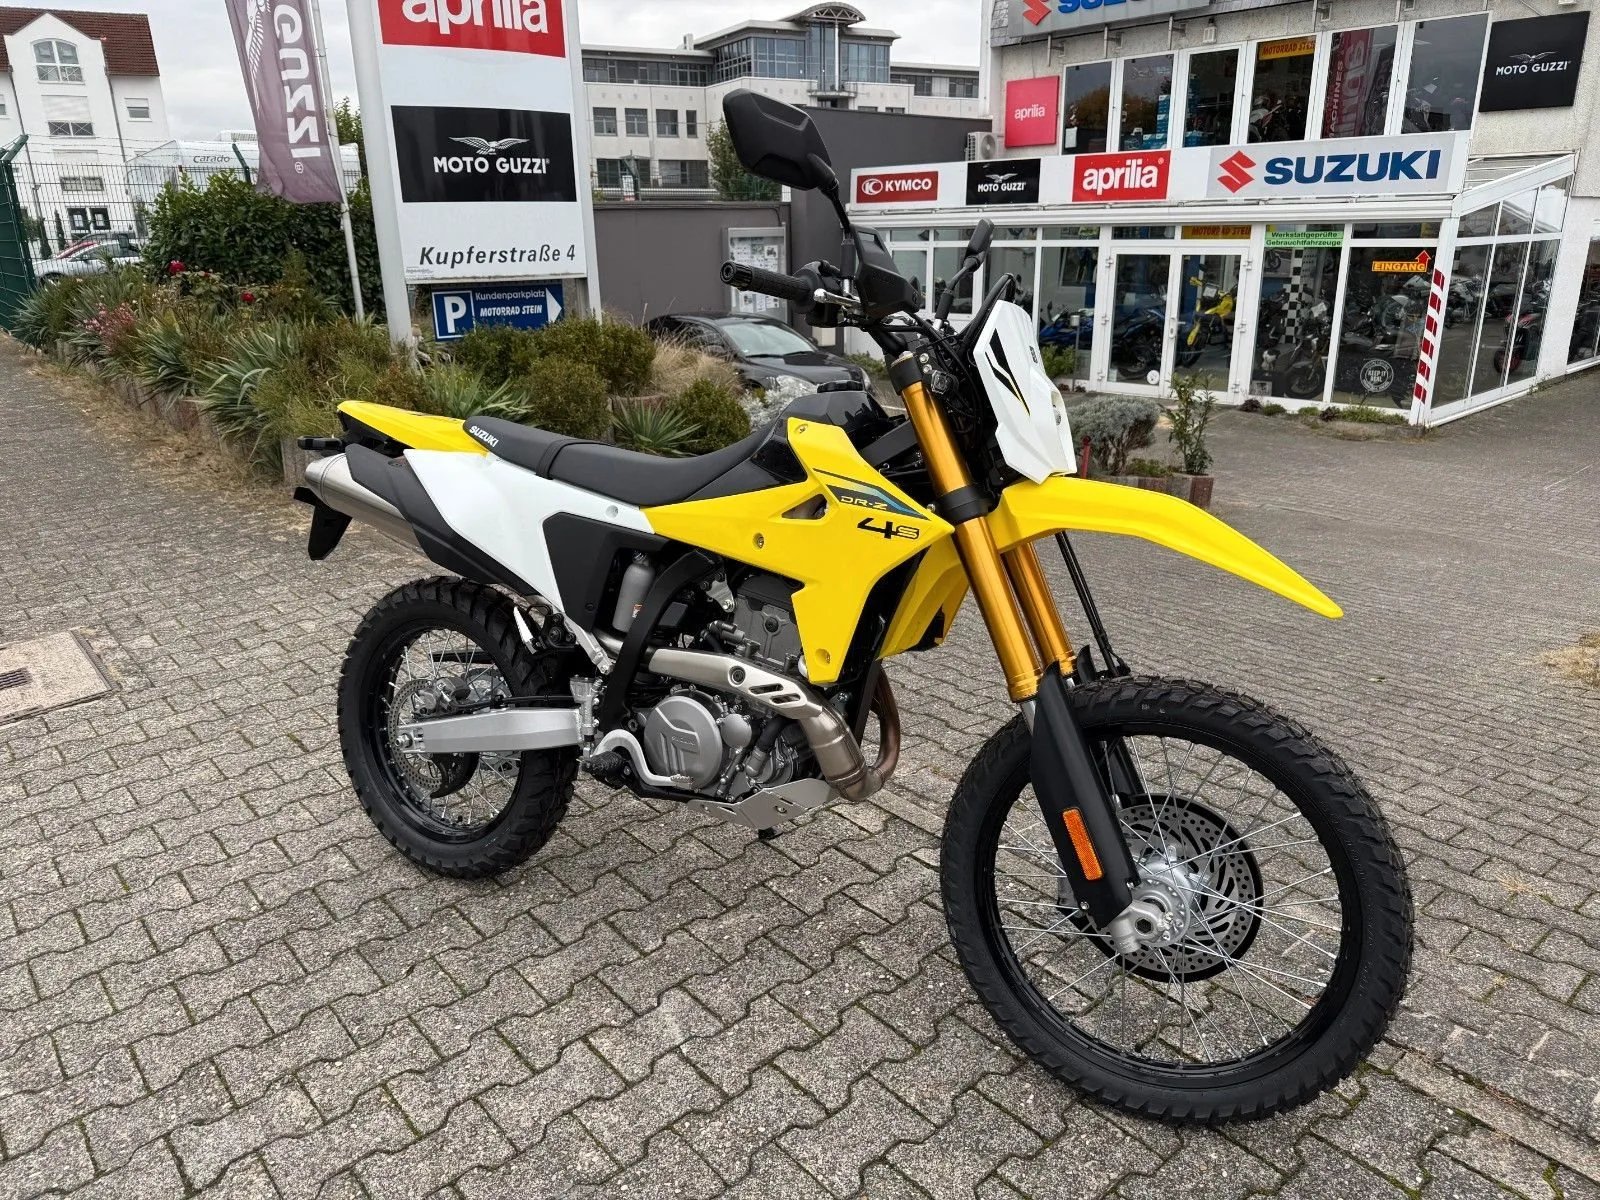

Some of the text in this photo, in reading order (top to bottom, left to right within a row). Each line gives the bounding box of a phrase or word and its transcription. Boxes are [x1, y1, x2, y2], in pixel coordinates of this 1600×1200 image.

[1496, 61, 1568, 75] MOTO GUZZI
[1014, 104, 1046, 121] aprilia
[433, 156, 489, 173] MOTO
[1264, 150, 1442, 185] SUZUKI
[1082, 159, 1159, 196] aprilia
[885, 178, 932, 192] KYMCO
[977, 181, 1026, 193] MOTO GUZZI
[1271, 231, 1338, 239] Werkstattgeprüfte
[1266, 239, 1341, 247] Gebrauchtfahrzeuge
[419, 244, 576, 269] Kupferstraße 4
[1374, 263, 1425, 271] EINGANG
[475, 290, 546, 302] Kundenparkplatz
[443, 296, 467, 334] P
[479, 304, 543, 318] MOTORRAD STEIN
[469, 425, 499, 447] SUZUKI
